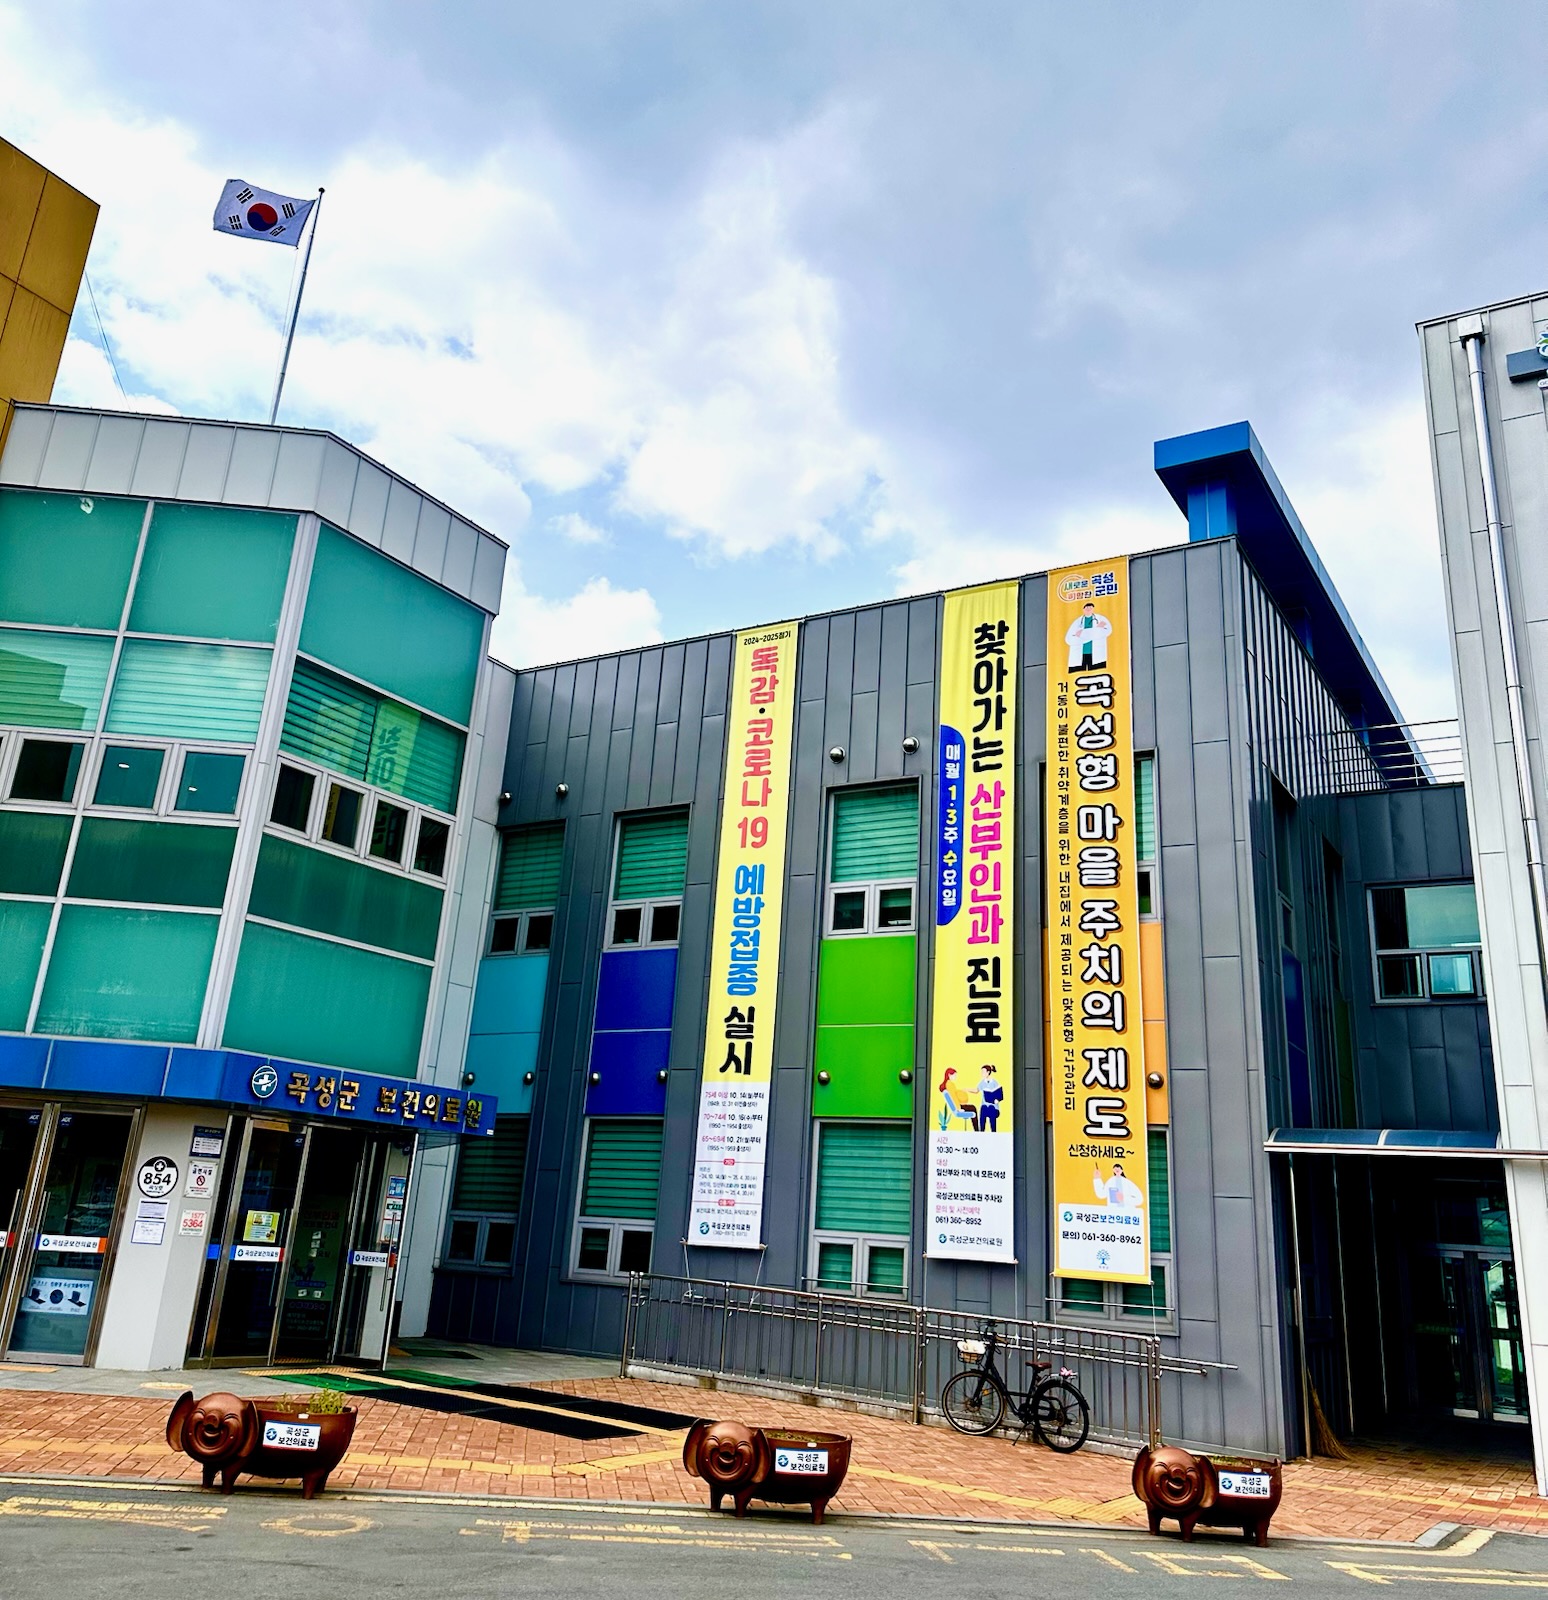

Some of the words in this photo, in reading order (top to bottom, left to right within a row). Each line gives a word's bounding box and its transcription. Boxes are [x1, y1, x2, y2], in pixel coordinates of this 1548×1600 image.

[1091, 572, 1114, 585] 곡성
[1095, 583, 1118, 596] 군민
[971, 620, 1009, 773] 찾아가는
[1057, 681, 1069, 719] 거동이
[1074, 673, 1119, 792] 곡성형
[1057, 724, 1069, 762] 불편한
[945, 744, 960, 779] 매월
[1057, 766, 1070, 834] 취약계층을
[967, 780, 1005, 945] 산부인과
[1058, 839, 1071, 866] 위한
[942, 850, 958, 907] 수요일
[727, 863, 766, 997] 예방접종
[1060, 933, 1073, 993] 제공되는
[965, 956, 1001, 1043] 진료
[1062, 998, 1074, 1043] 맞춤형
[719, 1006, 755, 1076] 실시
[1063, 1048, 1075, 1111] 건강관리
[287, 1072, 360, 1111] 곡성군
[375, 1086, 482, 1129] 보건의료원
[1080, 1047, 1131, 1138] 제도
[936, 1136, 948, 1144] 시간
[936, 1146, 954, 1154] 10:30
[962, 1147, 979, 1155] 14:00
[1068, 1144, 1135, 1158] 신청하세요~
[143, 1172, 172, 1186] 854
[936, 1192, 983, 1202] 곡성군보건의료원
[1076, 1212, 1140, 1226] 곡성군보건의료원
[52, 1239, 98, 1249] 곡성군보건의료원
[948, 1234, 1003, 1246] 곡성군보건의료원
[1082, 1232, 1142, 1244] 061-360-8962
[286, 1426, 310, 1437] 곡성군
[278, 1437, 316, 1448] 보건의료원
[790, 1463, 826, 1472] 보건의료원
[796, 1454, 820, 1462] 곡성군
[1234, 1486, 1268, 1495] 보건의료원
[1240, 1476, 1262, 1486] 곡성군
